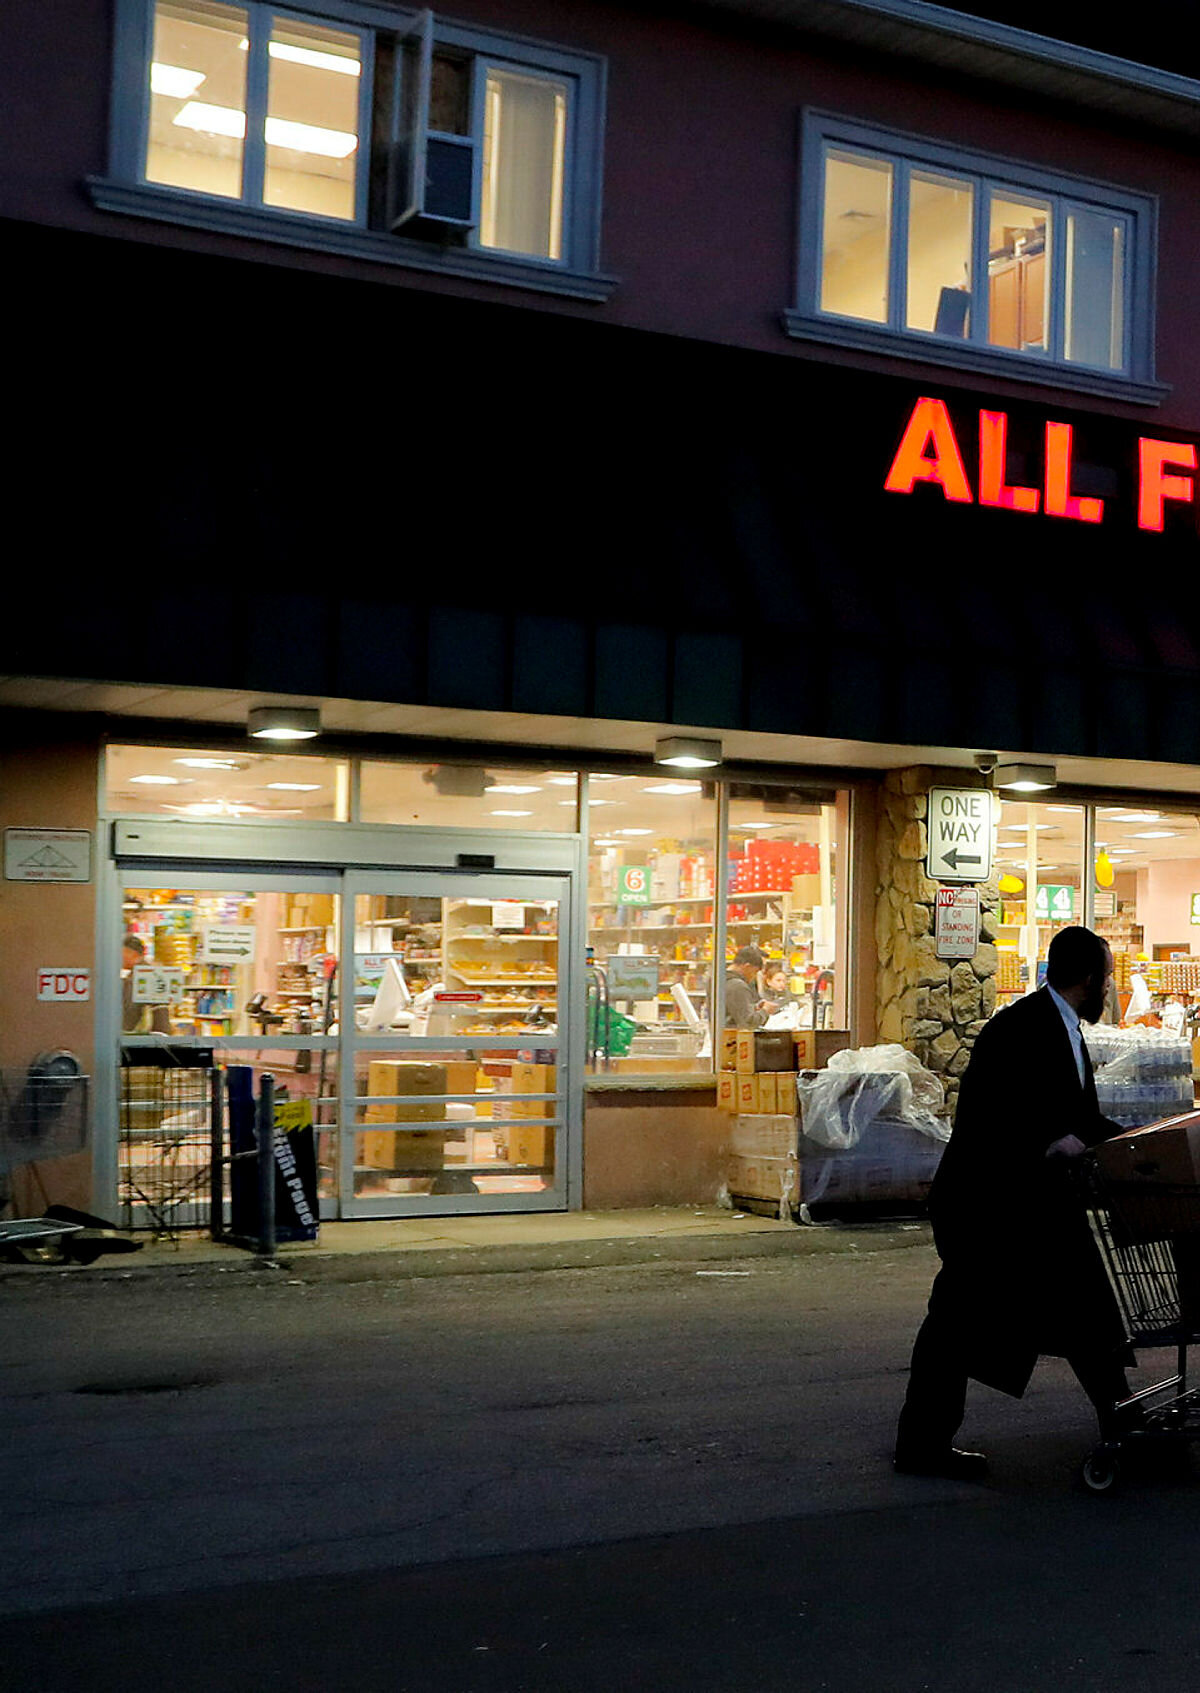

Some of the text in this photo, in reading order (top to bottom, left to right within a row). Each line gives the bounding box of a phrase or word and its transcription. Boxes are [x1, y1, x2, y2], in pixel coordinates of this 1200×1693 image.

[884, 396, 1104, 523] ALL
[941, 795, 981, 817] ONE
[940, 820, 981, 843] WAY
[624, 869, 644, 892] 6
[939, 891, 954, 905] NO
[1053, 887, 1071, 910] 4
[942, 923, 973, 931] STANDING
[40, 974, 88, 994] FDC
